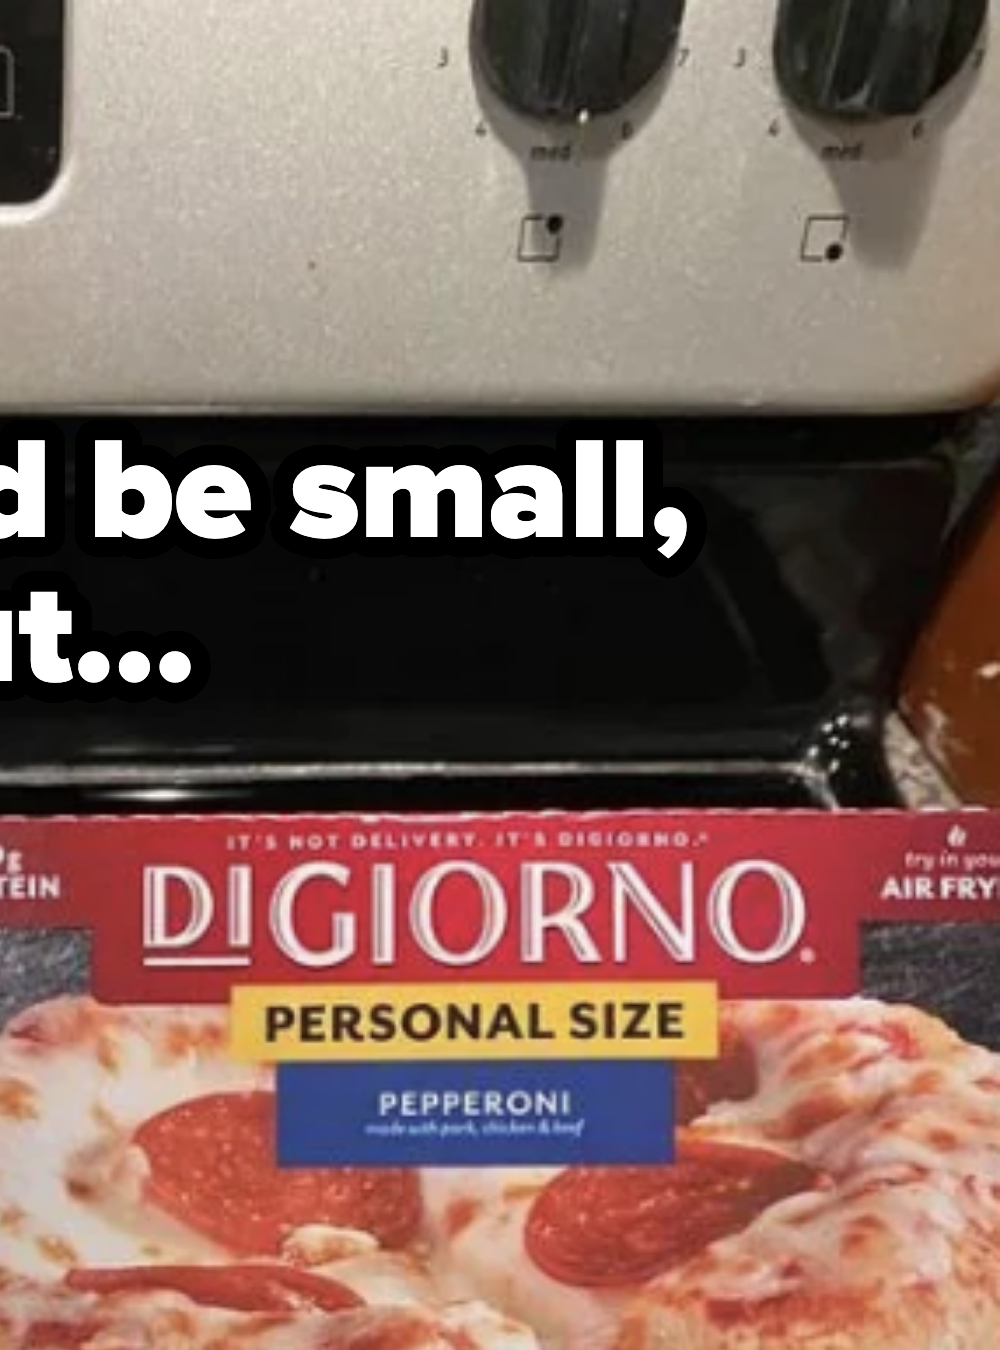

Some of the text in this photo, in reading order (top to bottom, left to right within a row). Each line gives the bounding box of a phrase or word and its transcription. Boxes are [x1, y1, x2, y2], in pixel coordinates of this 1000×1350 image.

[531, 142, 571, 162] med
[822, 142, 864, 162] med
[226, 834, 277, 851] IT'S
[289, 834, 338, 851] NOT
[350, 831, 484, 850] DELIVERY.
[496, 830, 546, 848] IT'S
[904, 850, 934, 871] try
[940, 849, 958, 867] in
[880, 875, 1000, 900] AIR FRY
[264, 1001, 685, 1043] PERSONAL SIZE
[378, 1090, 571, 1116] PEPPERONI
[408, 1118, 437, 1135] with
[552, 1117, 585, 1137] beef
